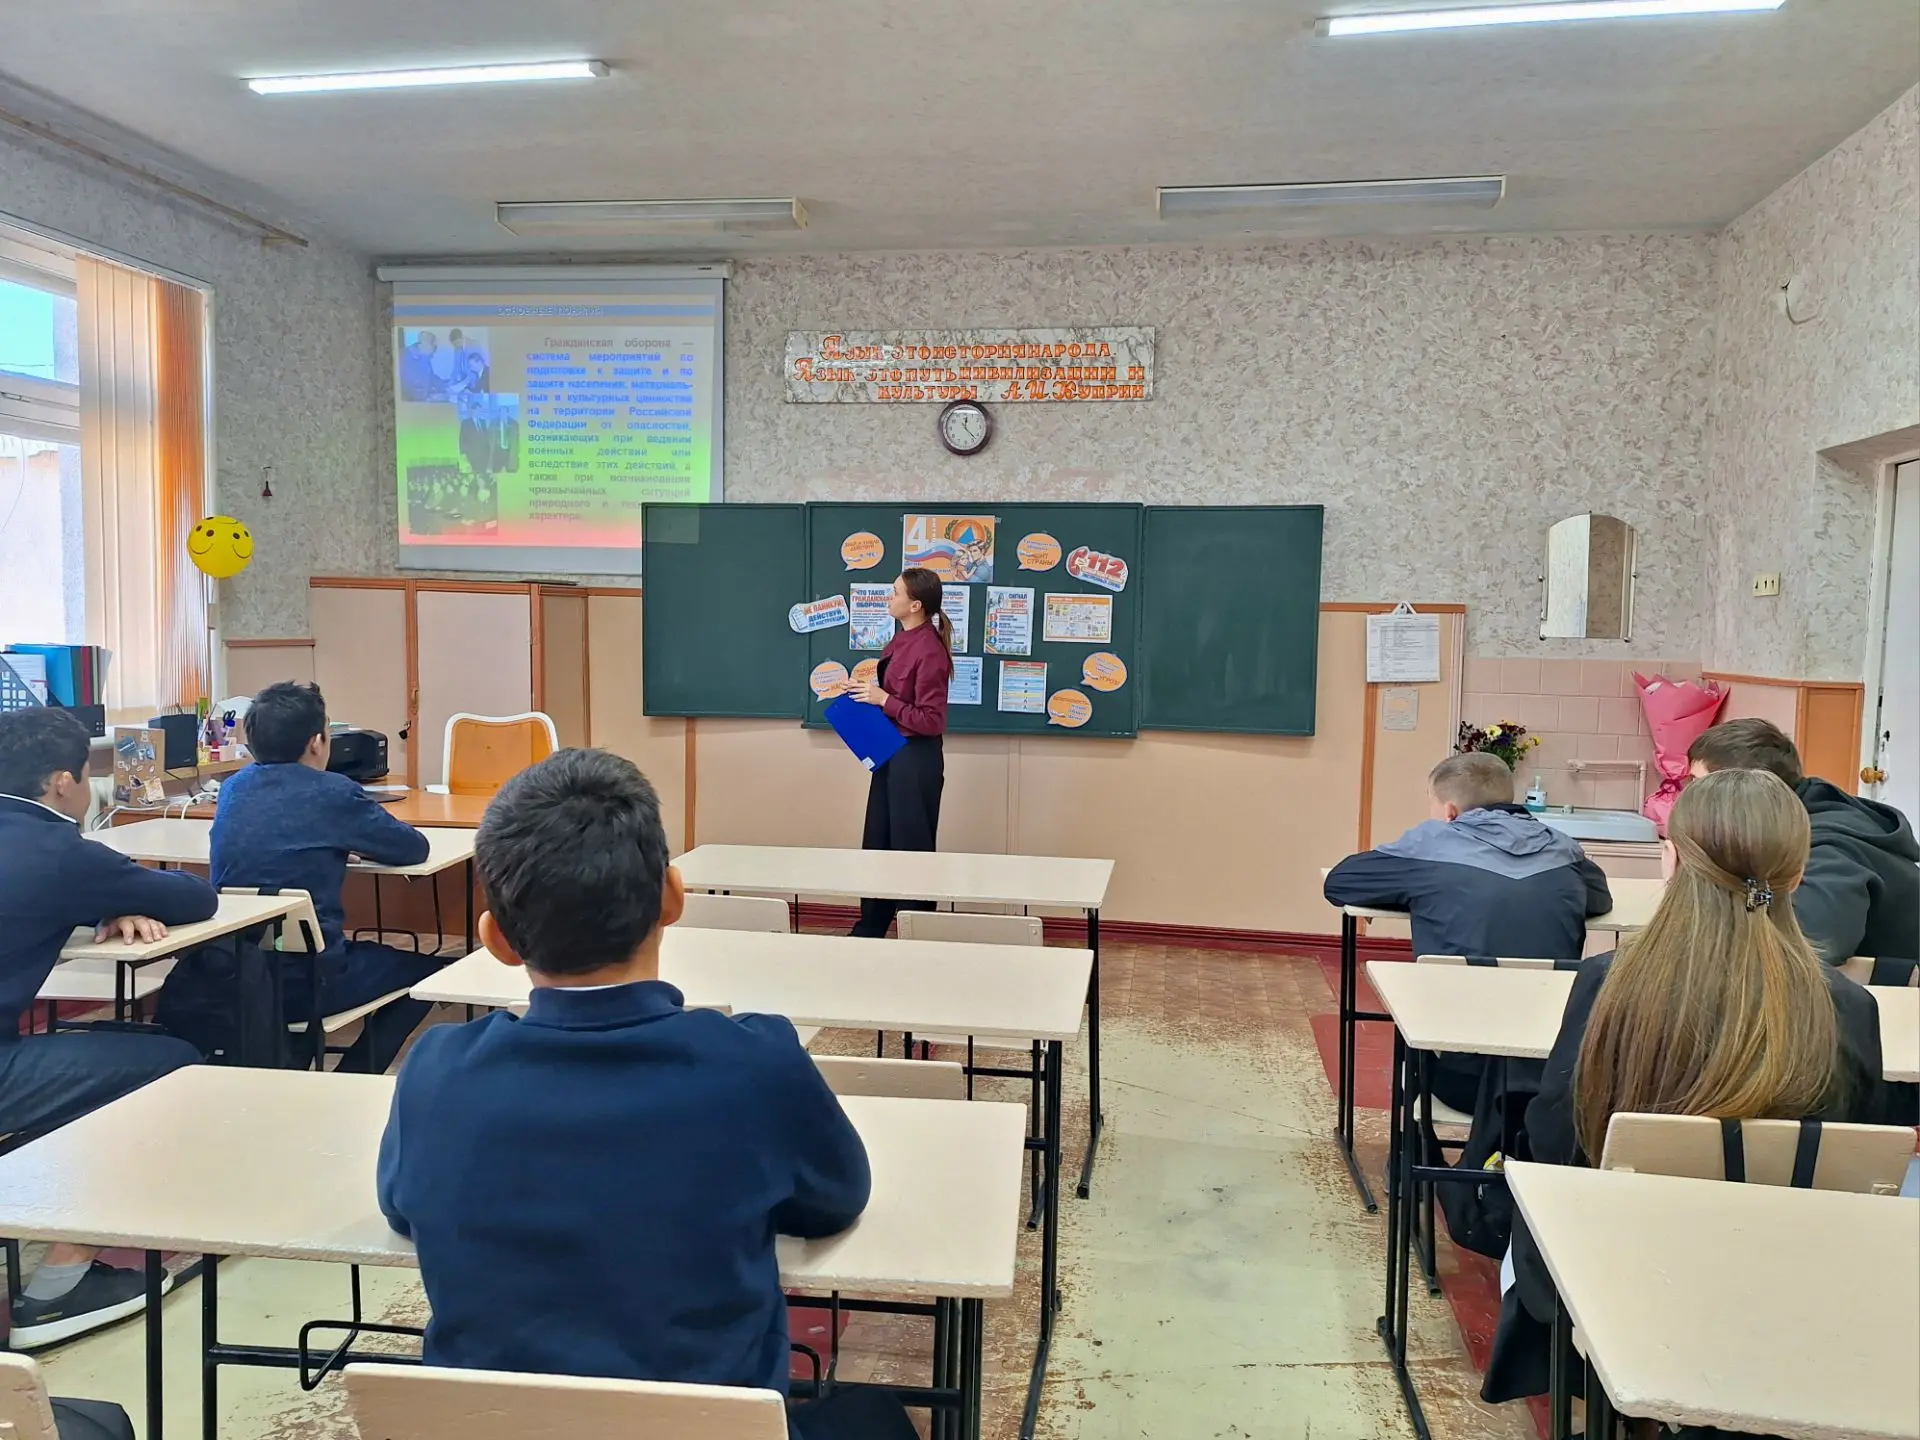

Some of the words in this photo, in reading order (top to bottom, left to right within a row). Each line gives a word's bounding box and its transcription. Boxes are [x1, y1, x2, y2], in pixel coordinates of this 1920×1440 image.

[544, 337, 614, 349] Гражданская
[624, 337, 671, 349] оборона
[526, 353, 570, 361] система
[589, 352, 661, 363] мероприятий
[527, 407, 540, 416] на
[630, 406, 692, 416] Российской
[528, 419, 587, 431] Федерации
[528, 434, 600, 444] возникающих
[613, 435, 633, 444] при
[527, 447, 574, 455] военных
[597, 447, 648, 456] действий
[528, 461, 589, 469] вследствие
[574, 474, 594, 483] при
[906, 517, 929, 553] 4
[1087, 552, 1124, 578] 112
